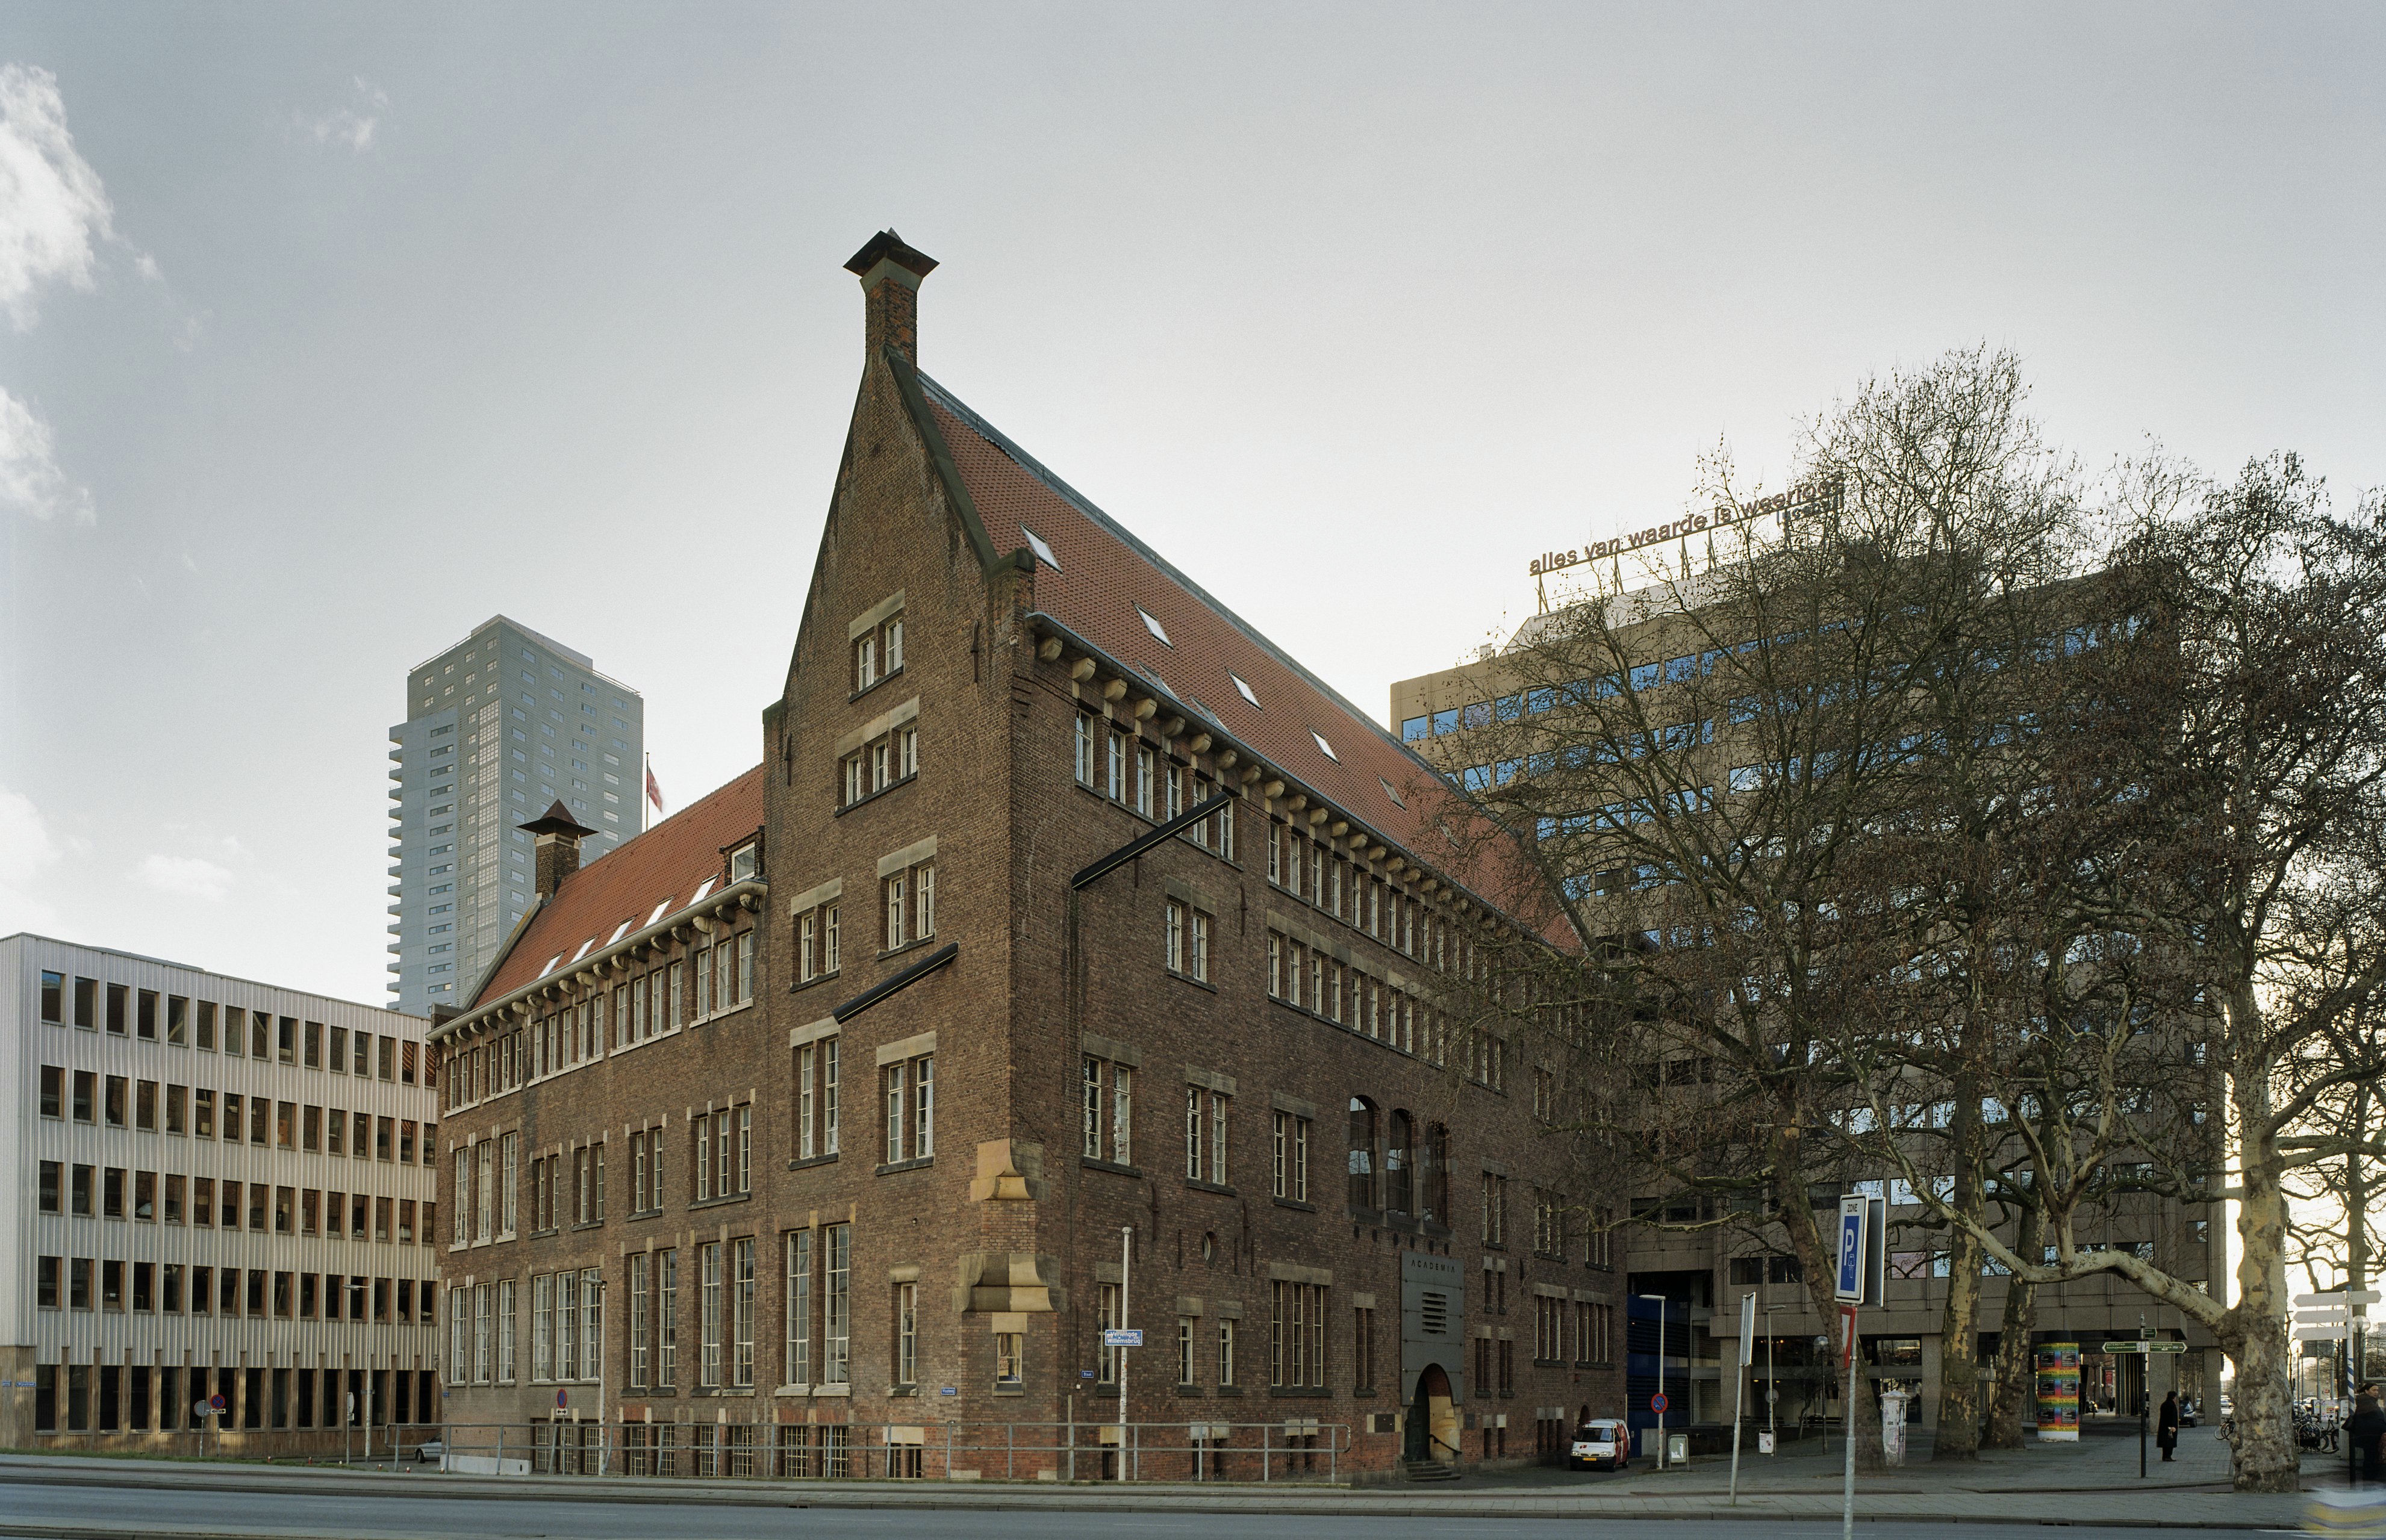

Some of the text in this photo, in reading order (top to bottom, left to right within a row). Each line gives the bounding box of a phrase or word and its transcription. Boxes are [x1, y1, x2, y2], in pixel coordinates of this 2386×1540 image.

[1530, 550, 1577, 573] alles
[1584, 538, 1621, 559] van
[1628, 514, 1707, 546] waarde
[1715, 506, 1732, 525] is
[1847, 1203, 1858, 1212] ZONE
[1412, 1259, 1455, 1273] ACADEMIA
